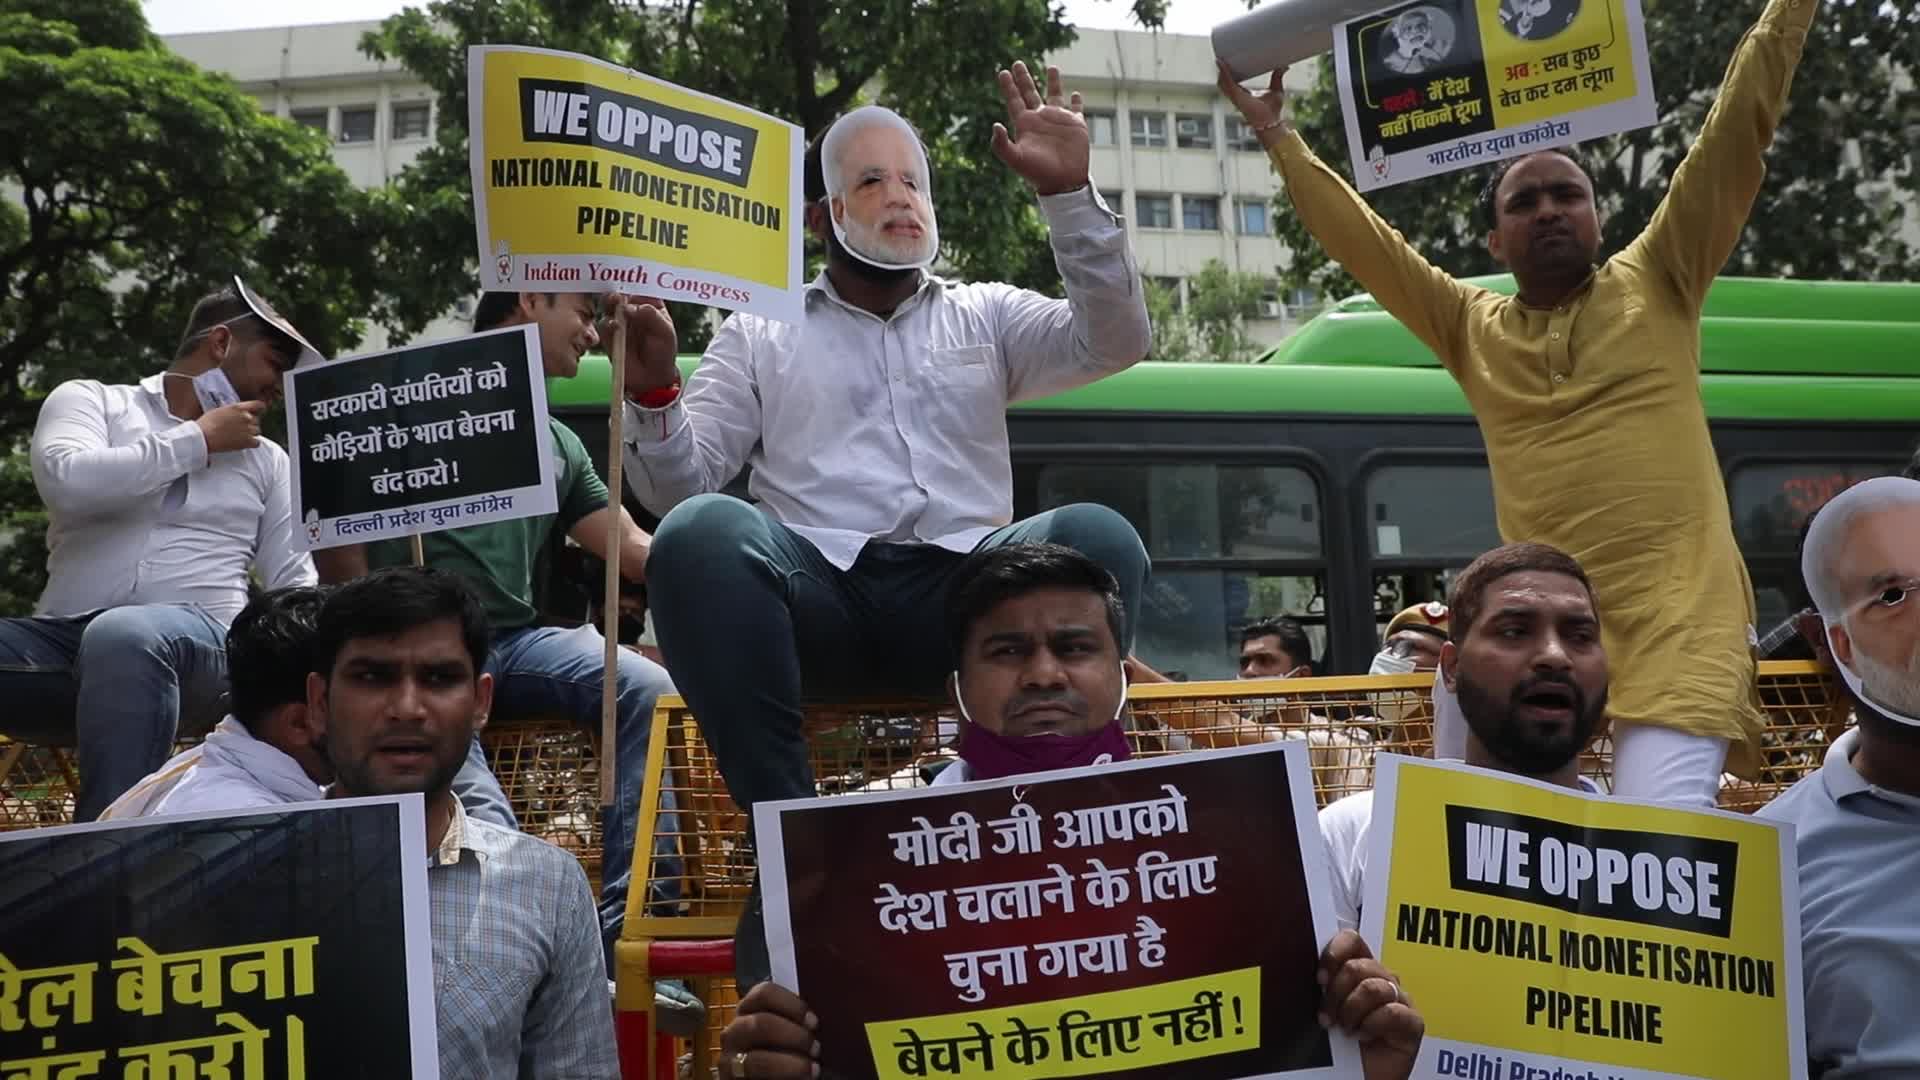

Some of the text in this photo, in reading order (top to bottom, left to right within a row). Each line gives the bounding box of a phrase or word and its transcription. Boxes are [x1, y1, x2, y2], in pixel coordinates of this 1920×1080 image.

[1427, 79, 1444, 101] मैं
[1445, 77, 1472, 97] देश
[1504, 63, 1529, 81] अब
[1541, 52, 1569, 73] सब
[1572, 43, 1602, 70] कुछ
[1523, 82, 1550, 102] कर
[1551, 76, 1579, 95] दम
[1580, 66, 1615, 93] लूंगा
[533, 89, 742, 176] WE OPPOSE
[1378, 112, 1410, 138] नहीं
[1410, 103, 1453, 132] बिकने
[1454, 99, 1483, 125] दूंगा
[1426, 120, 1571, 166] भारतीय युवा कांग्रेस
[491, 159, 781, 231] NATIONAL MONETISATION
[577, 206, 689, 250] PIPELINE
[523, 262, 750, 304] Indian Youth Congress
[310, 361, 507, 421] सरकारी संपत्तियों को
[310, 410, 515, 462] कौड़ियों के भाव बेचना
[370, 468, 404, 495] बंद
[335, 495, 514, 536] दिल्ली प्रदेश युवा कांग्रेस
[889, 785, 1189, 867] मोदी जी आपको
[874, 850, 1219, 934] देश चलाने के लिए
[1465, 821, 1722, 920] WE OPPOSE
[944, 915, 1168, 1002] चुना गया है
[1396, 904, 1776, 997] NATIONAL MONETISATION
[0, 936, 319, 1031] रेल बेचना
[1525, 986, 1664, 1045] PIPELINE
[894, 1022, 995, 1078] बेचने
[998, 1017, 1051, 1066] के
[1054, 1011, 1142, 1063] लिए
[1437, 1049, 1601, 1080] Delhi Prad
